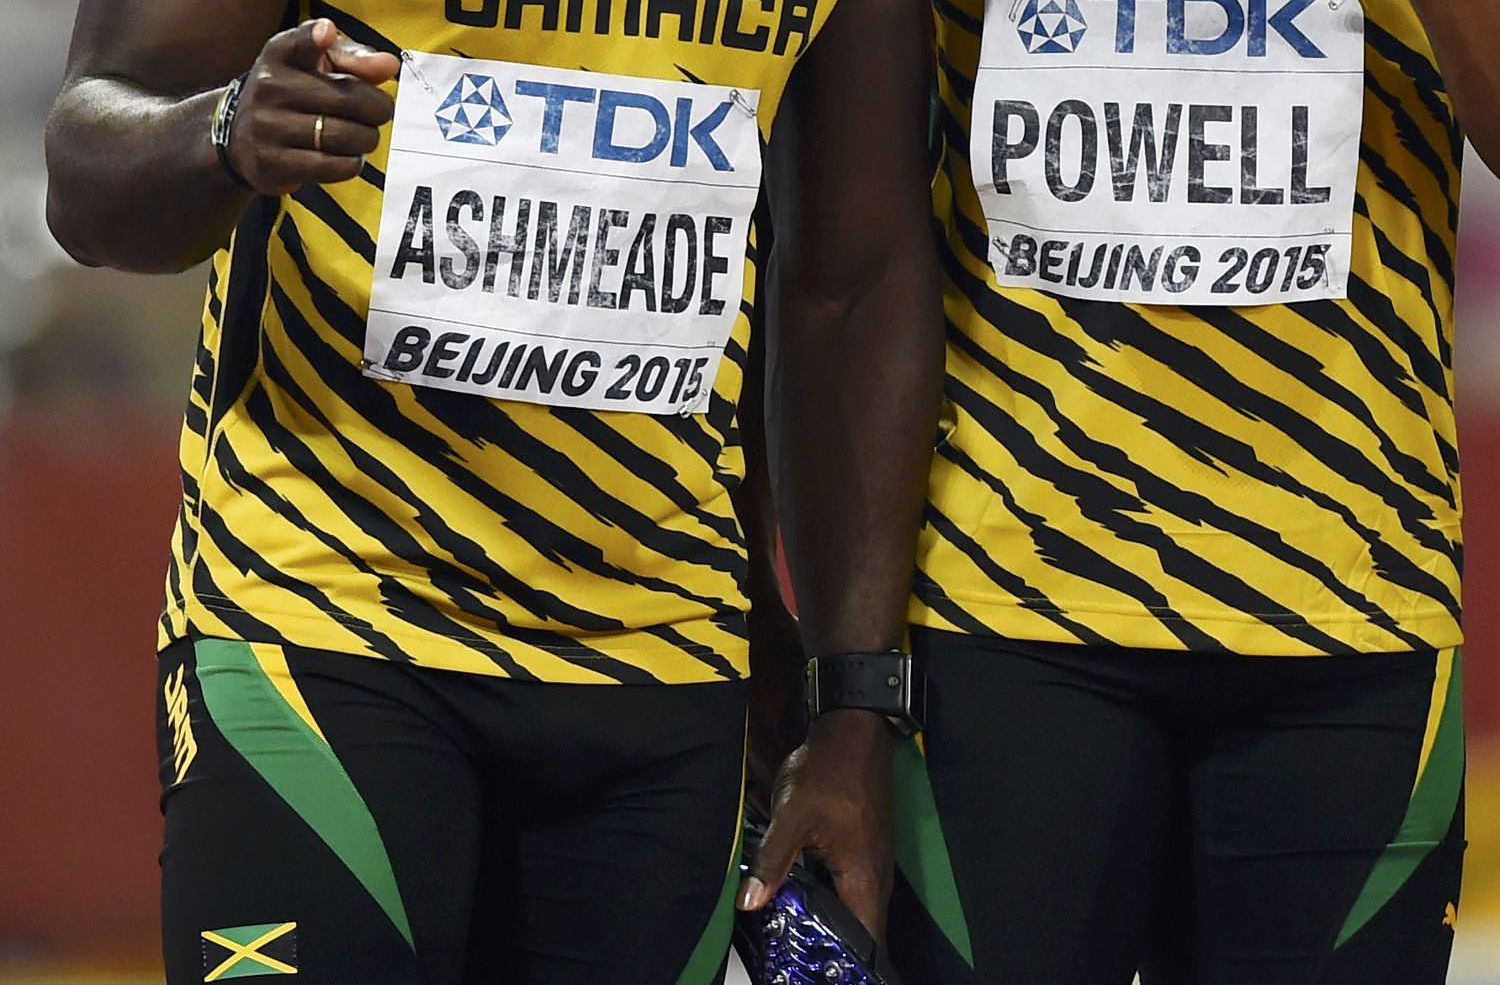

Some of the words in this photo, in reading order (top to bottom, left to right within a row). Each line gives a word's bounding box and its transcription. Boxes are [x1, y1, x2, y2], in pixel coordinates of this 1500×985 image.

[514, 79, 736, 172] TDK
[991, 99, 1332, 206] POWELL
[390, 185, 733, 316] ASHMEADE
[1003, 233, 1201, 293] BEIJING
[1211, 244, 1332, 295] 2015
[384, 325, 602, 397] BEIJING
[604, 355, 710, 404] 2015
